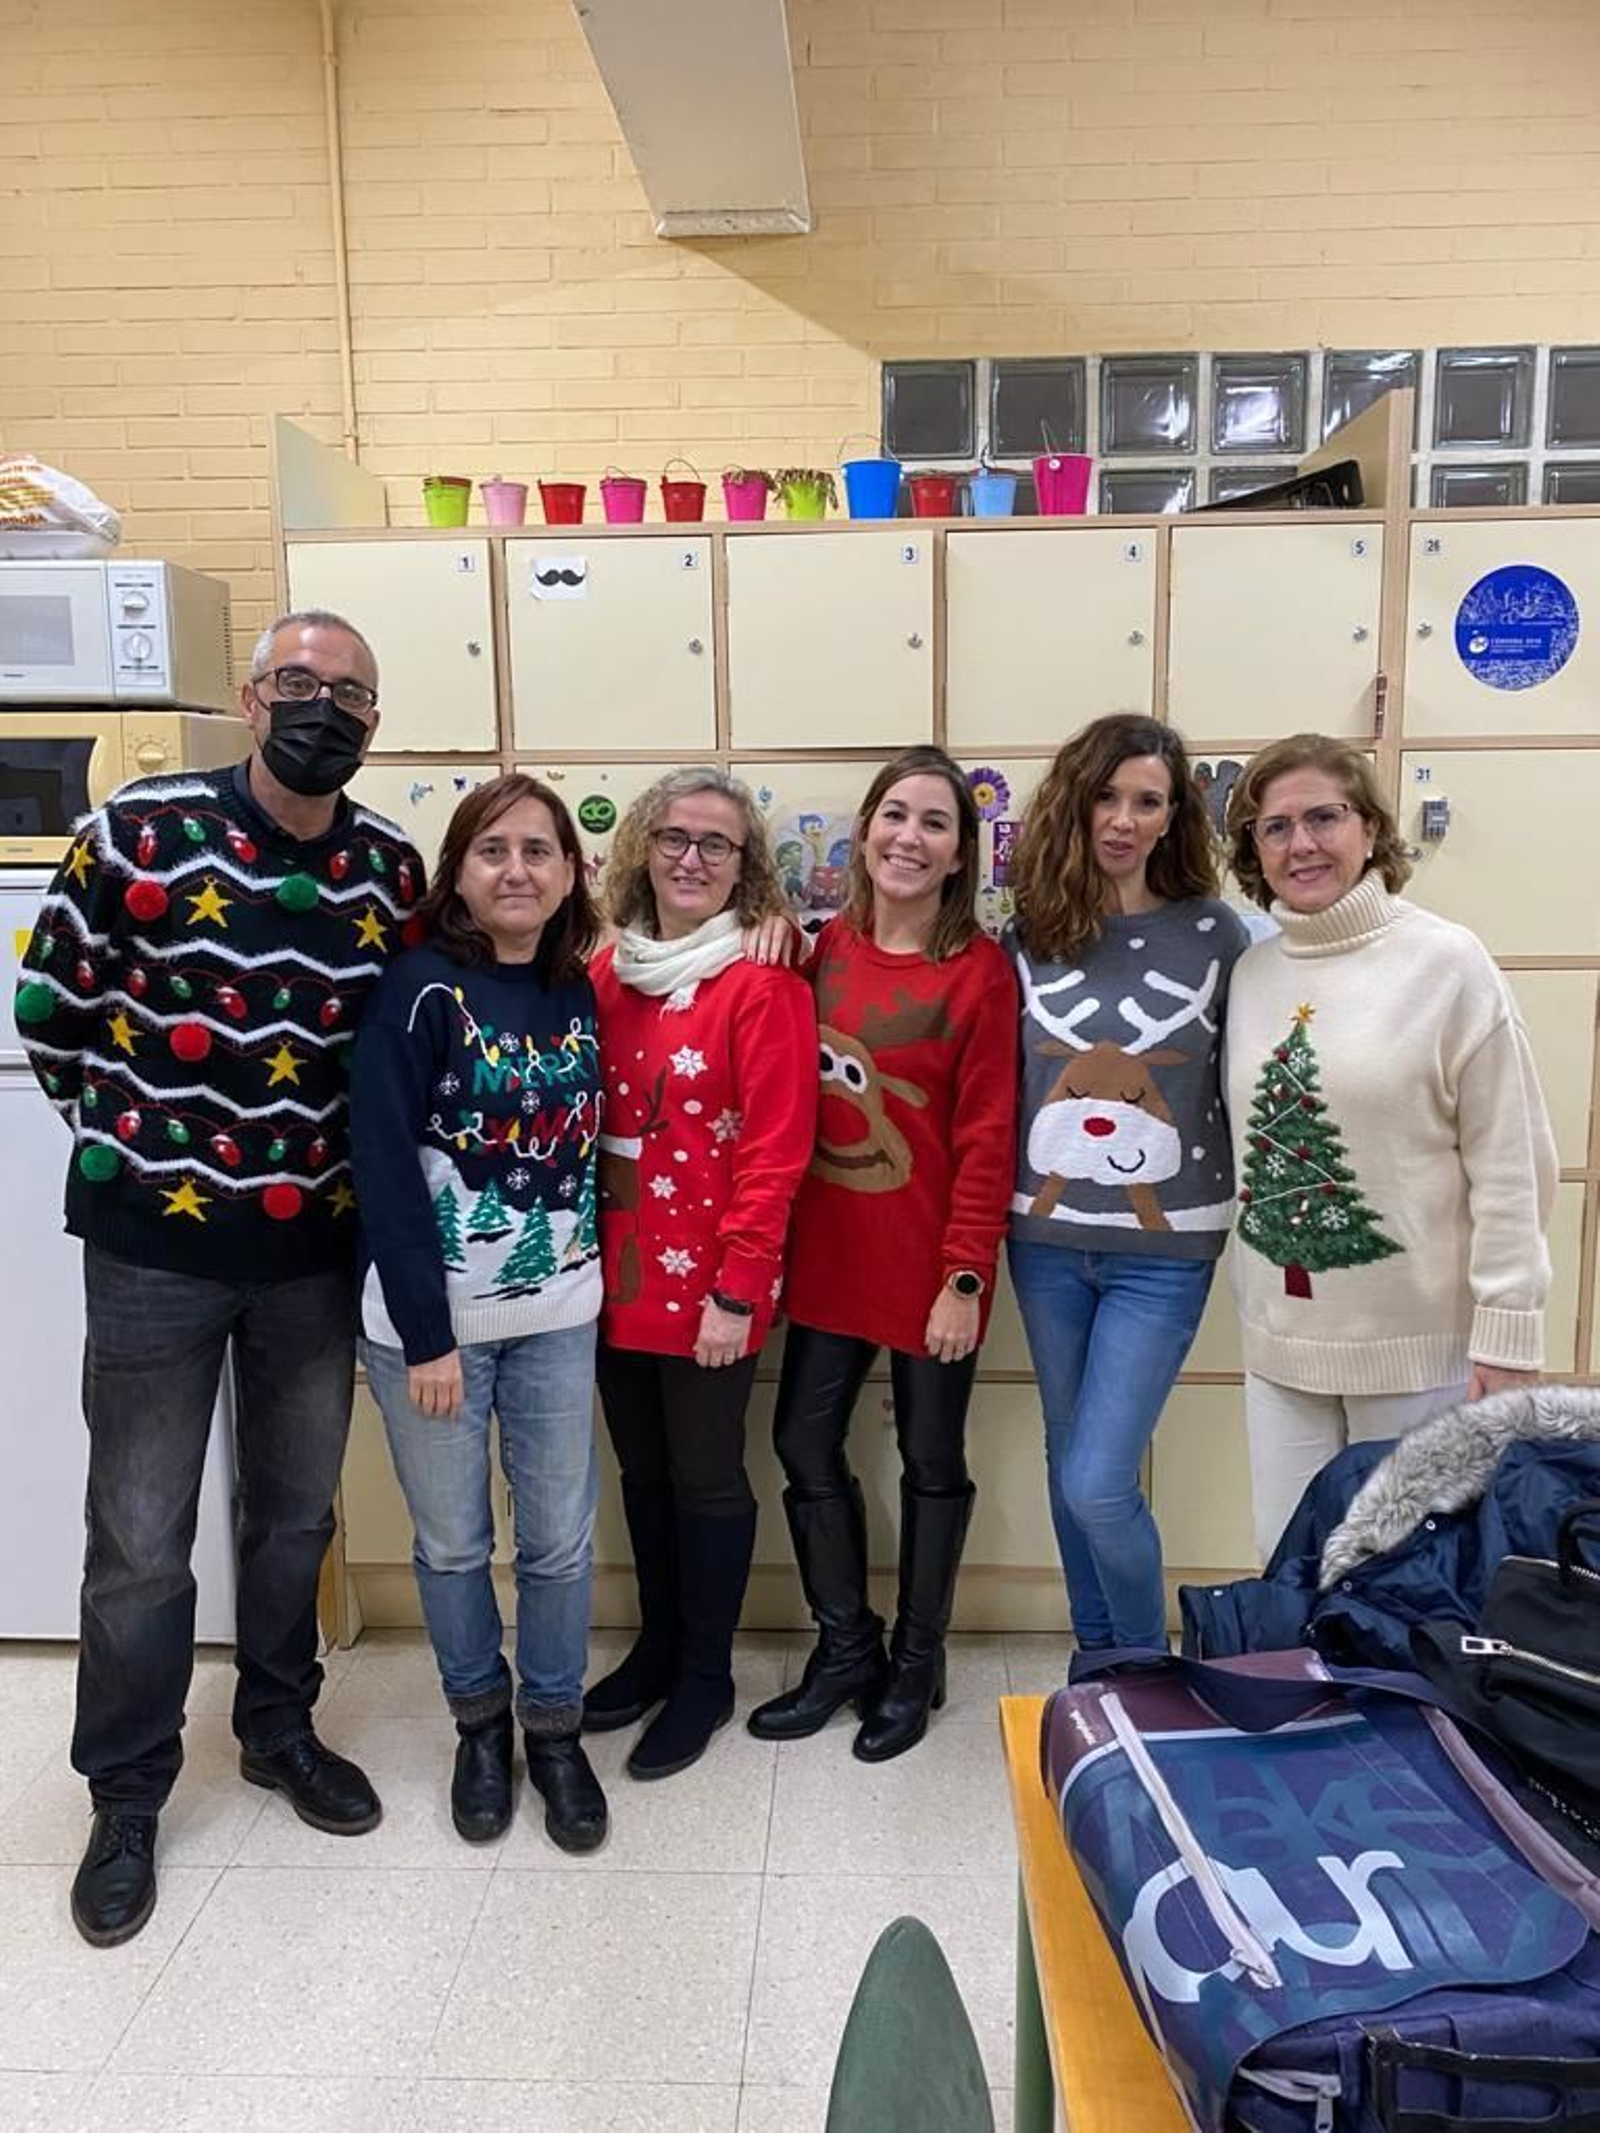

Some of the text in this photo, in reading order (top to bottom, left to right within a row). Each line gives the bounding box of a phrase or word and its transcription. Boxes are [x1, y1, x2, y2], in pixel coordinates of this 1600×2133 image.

[1129, 545, 1137, 558] 4
[1356, 540, 1364, 554] 5
[1427, 539, 1440, 552] 26
[685, 553, 693, 566] 2
[905, 547, 914, 560] 3
[1417, 768, 1430, 780] 31
